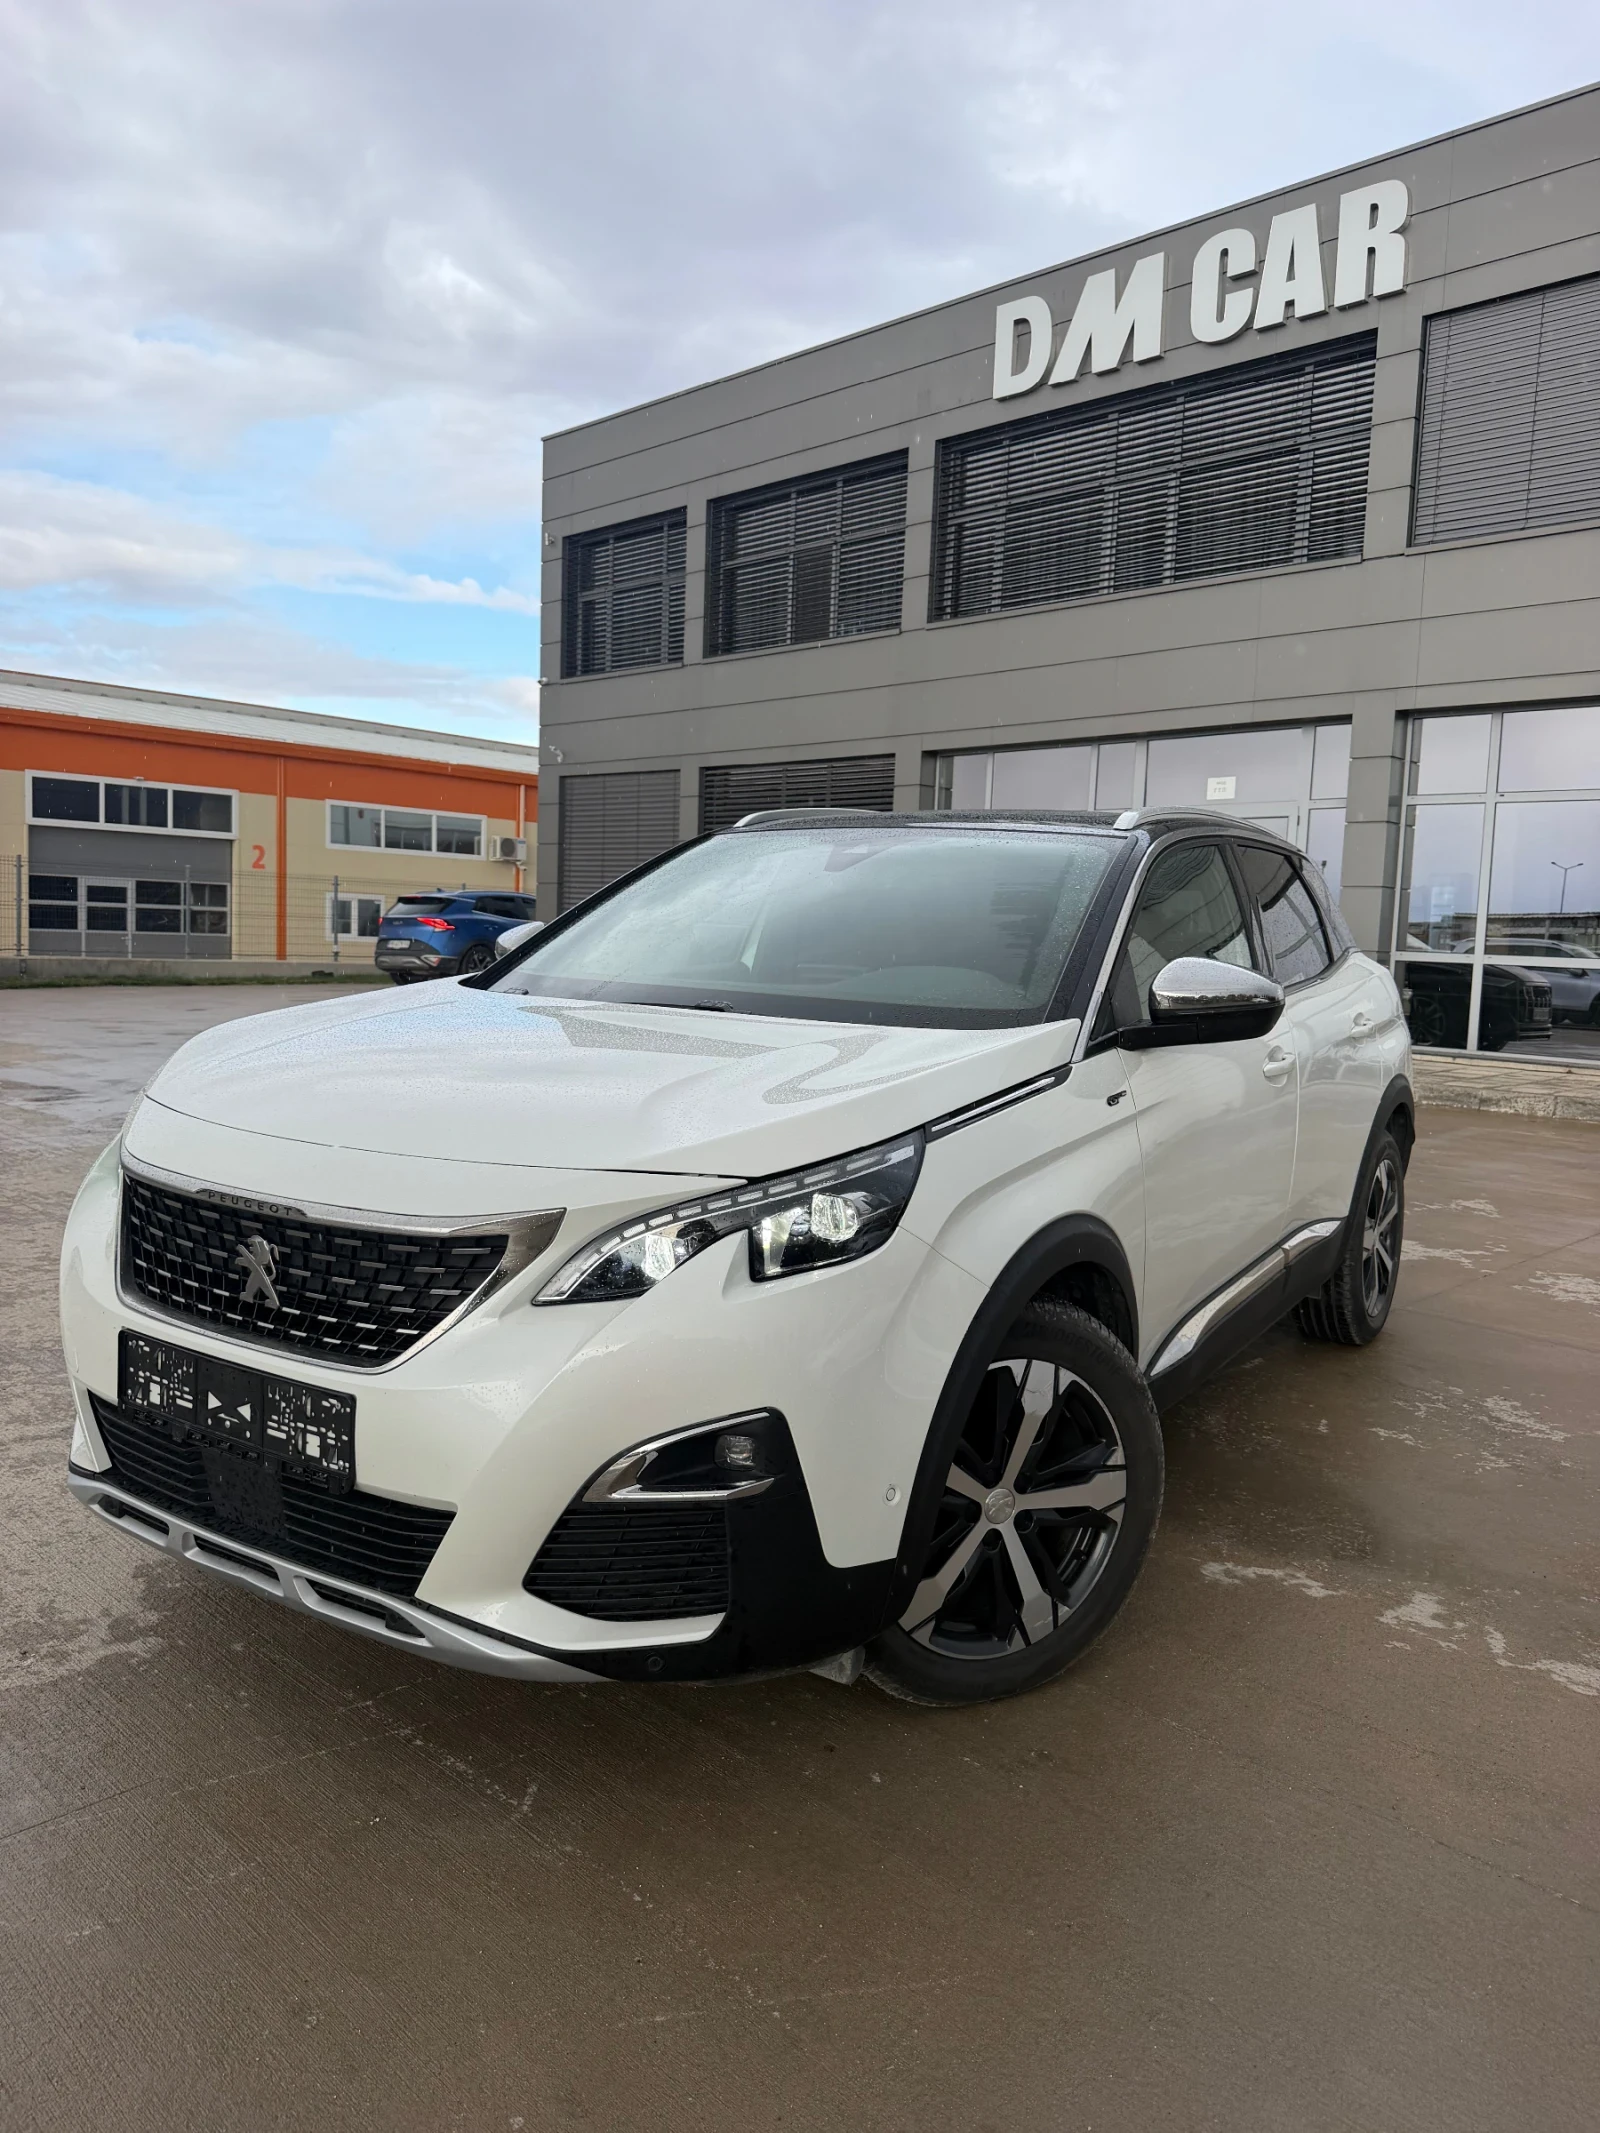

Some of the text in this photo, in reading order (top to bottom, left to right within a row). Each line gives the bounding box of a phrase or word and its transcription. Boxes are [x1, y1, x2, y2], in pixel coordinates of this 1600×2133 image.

[992, 179, 1411, 401] DM CAR
[252, 844, 266, 869] 2
[208, 1191, 292, 1216] PEUGEOT
